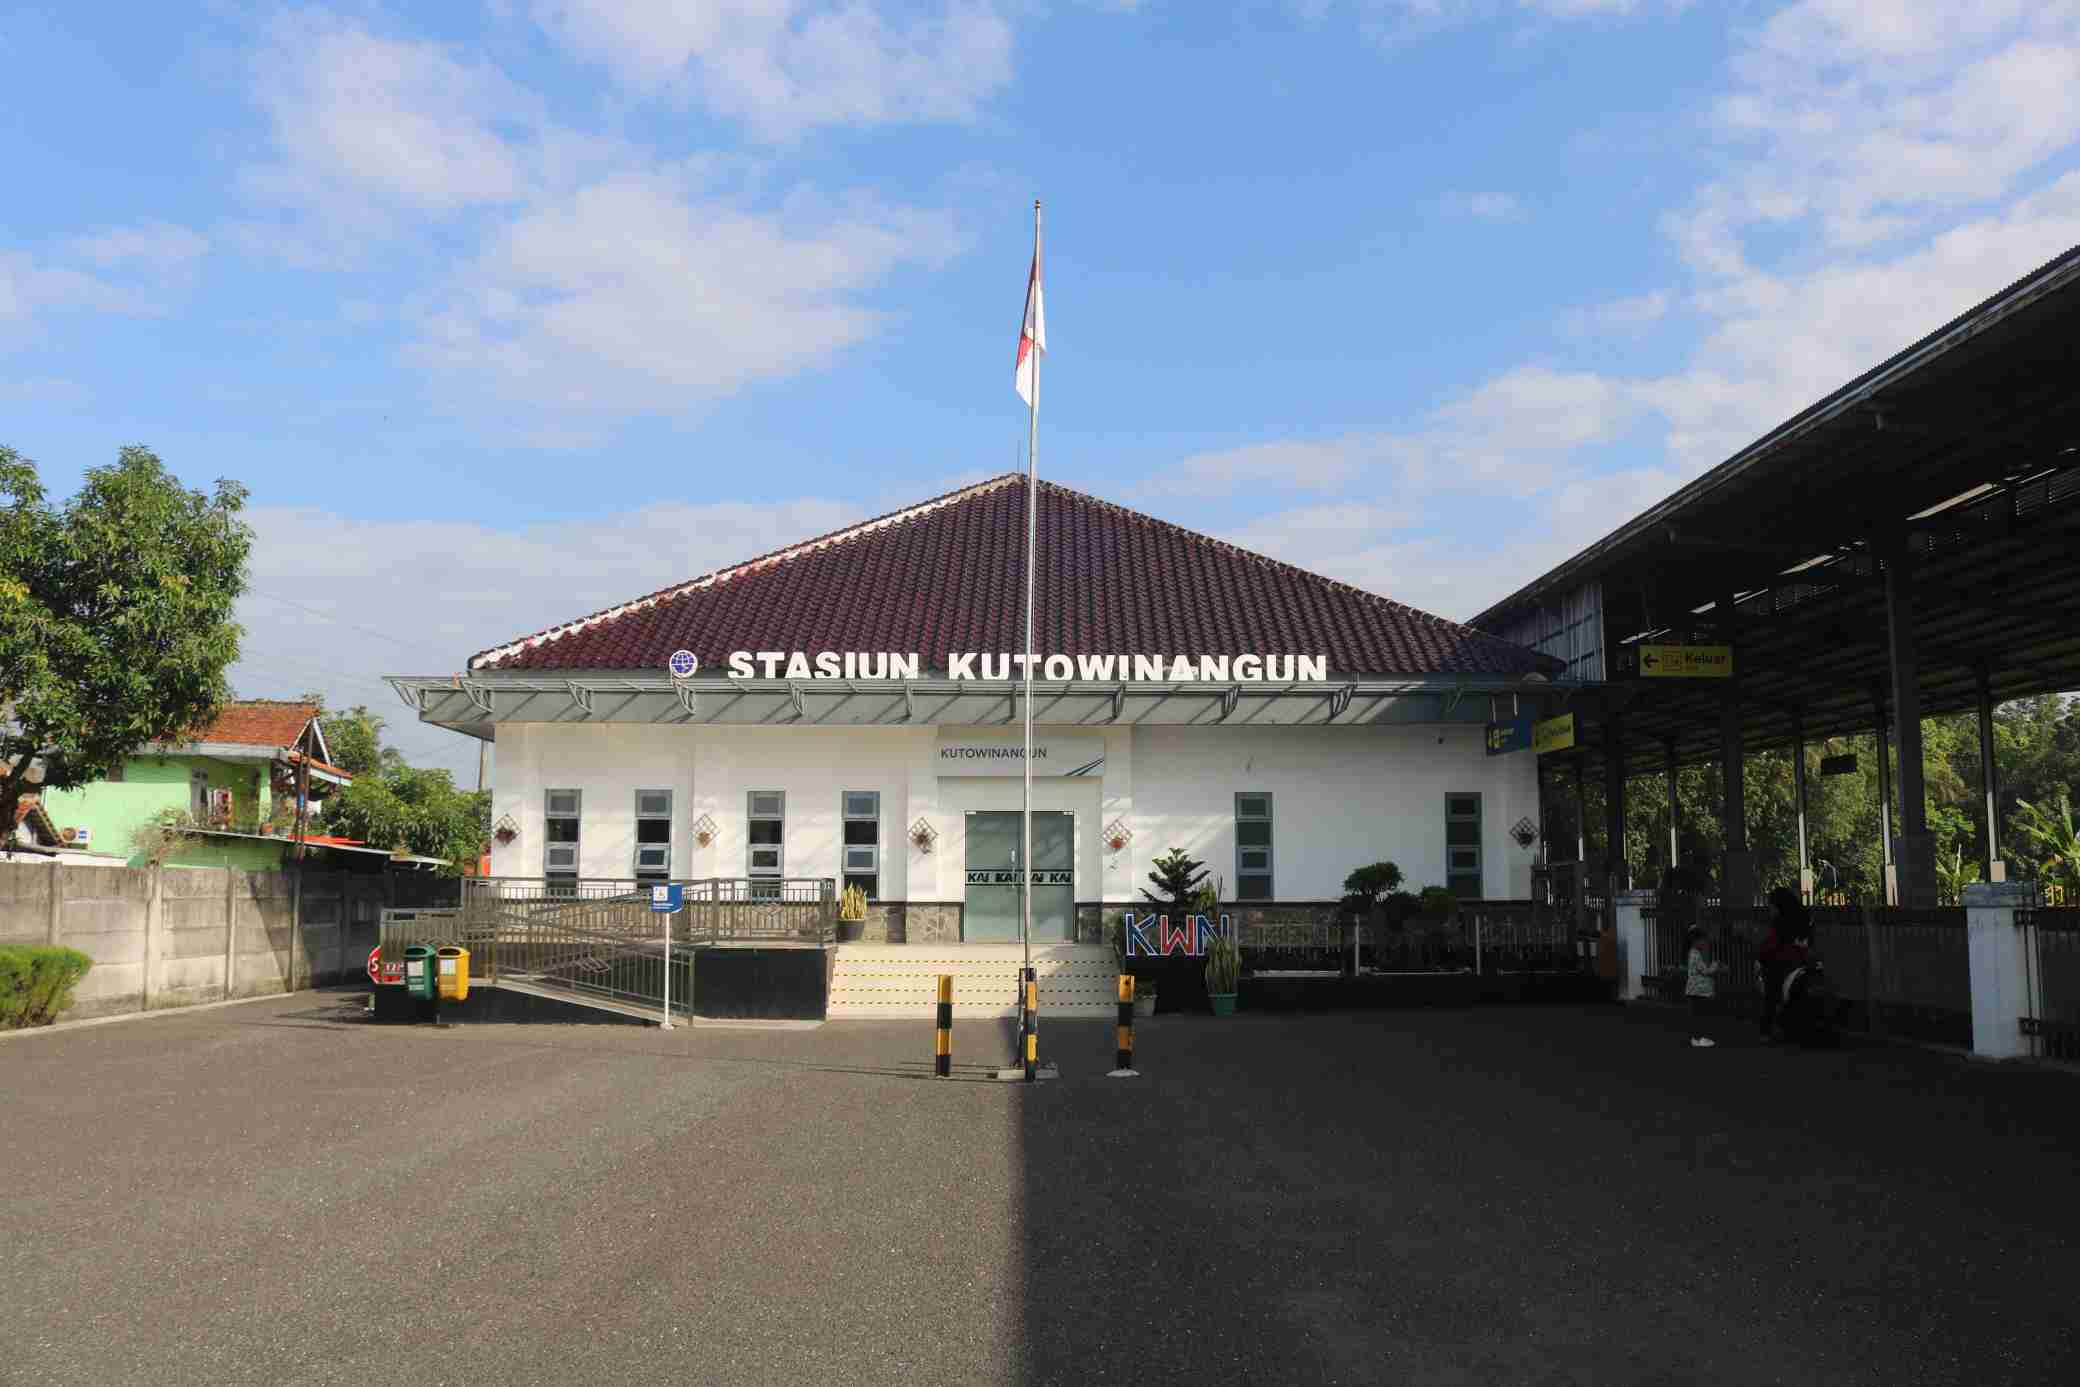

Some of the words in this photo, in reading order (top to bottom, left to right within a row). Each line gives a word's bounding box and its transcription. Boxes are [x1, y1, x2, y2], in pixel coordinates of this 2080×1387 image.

[728, 651, 919, 680] STASIUN
[948, 652, 1327, 681] KUTOWINANGUN
[967, 872, 990, 883] KAI
[995, 872, 1017, 883] KAI
[1050, 872, 1072, 883] KAI
[1125, 912, 1230, 957] KWN
